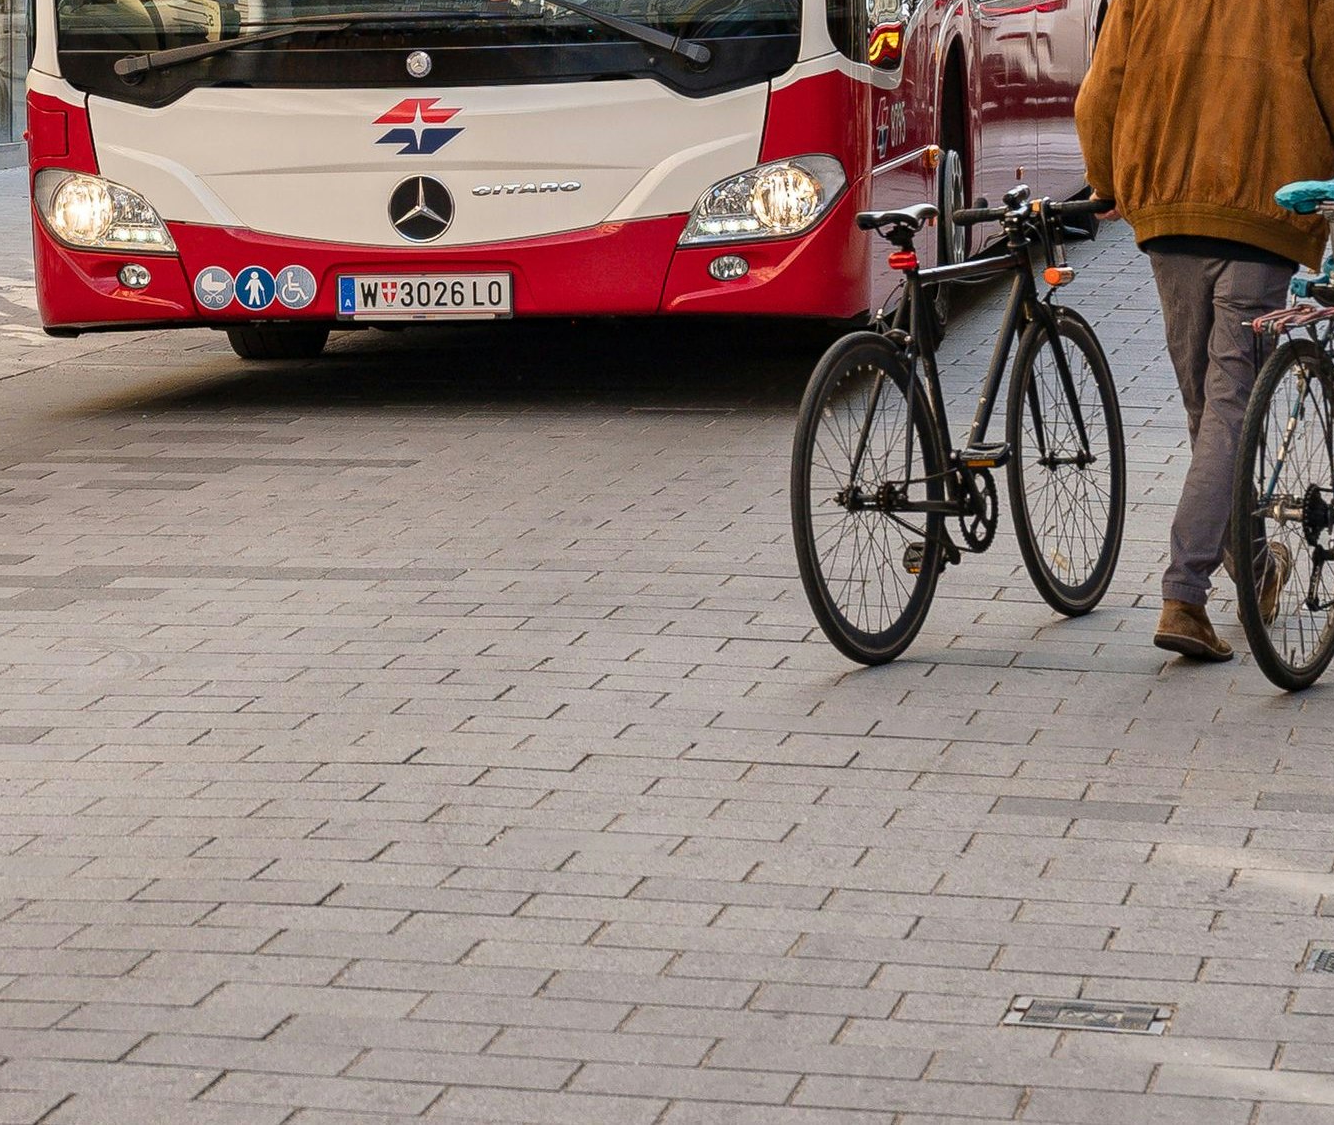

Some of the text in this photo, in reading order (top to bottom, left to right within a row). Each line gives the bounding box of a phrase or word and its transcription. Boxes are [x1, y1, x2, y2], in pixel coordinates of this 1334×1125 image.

[471, 179, 582, 197] CITARO
[344, 298, 353, 307] A
[360, 281, 502, 307] W 3026 LO
